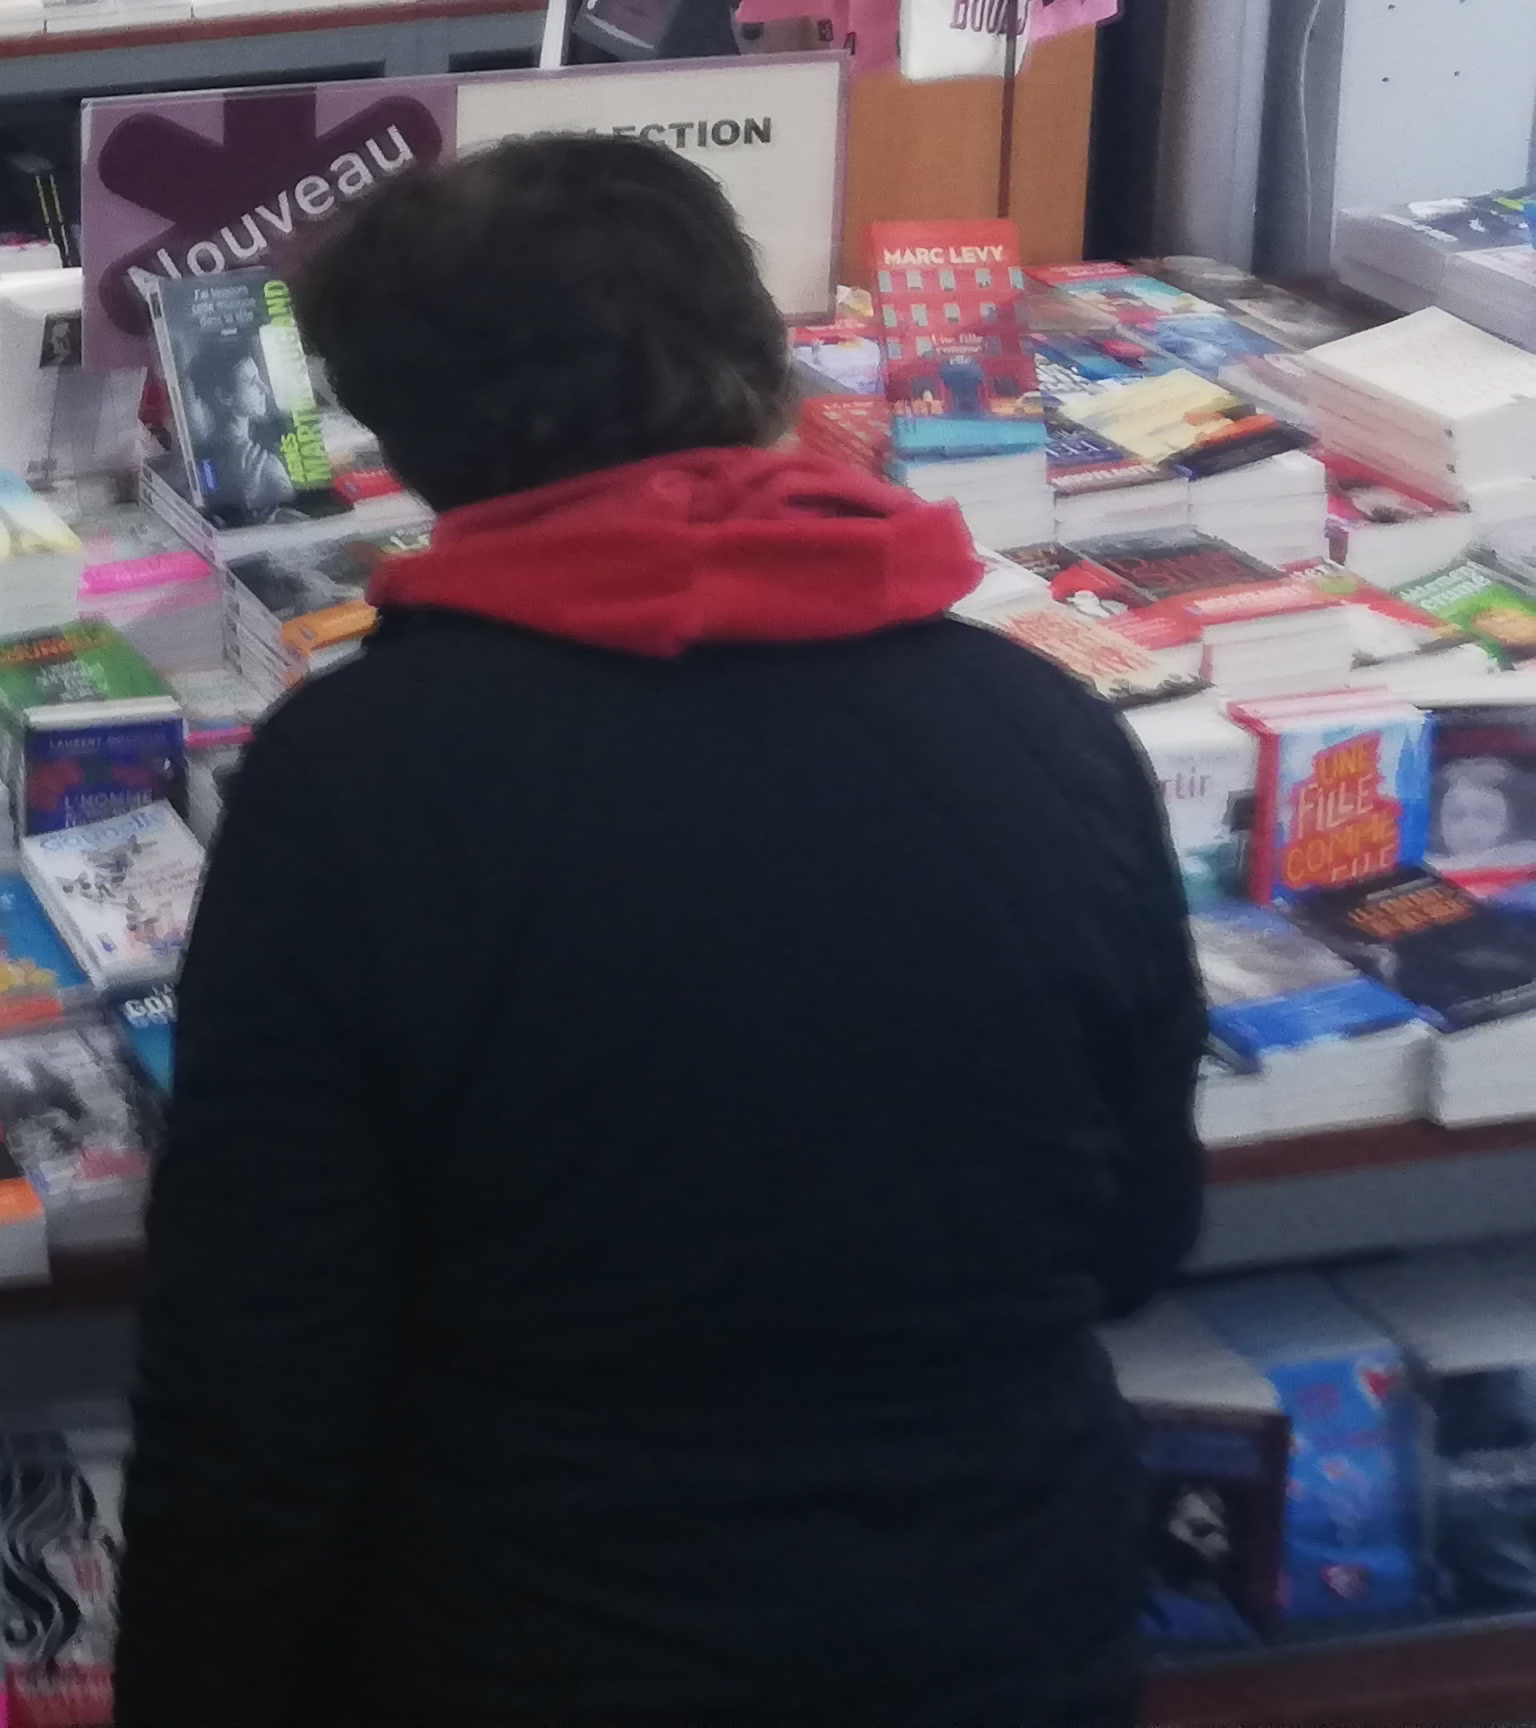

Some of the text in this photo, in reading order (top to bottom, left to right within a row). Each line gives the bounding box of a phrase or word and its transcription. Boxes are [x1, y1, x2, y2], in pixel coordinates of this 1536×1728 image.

[128, 121, 416, 285] Nouveau
[883, 244, 1004, 265] MARC LEVY
[1286, 809, 1397, 881] COMME
